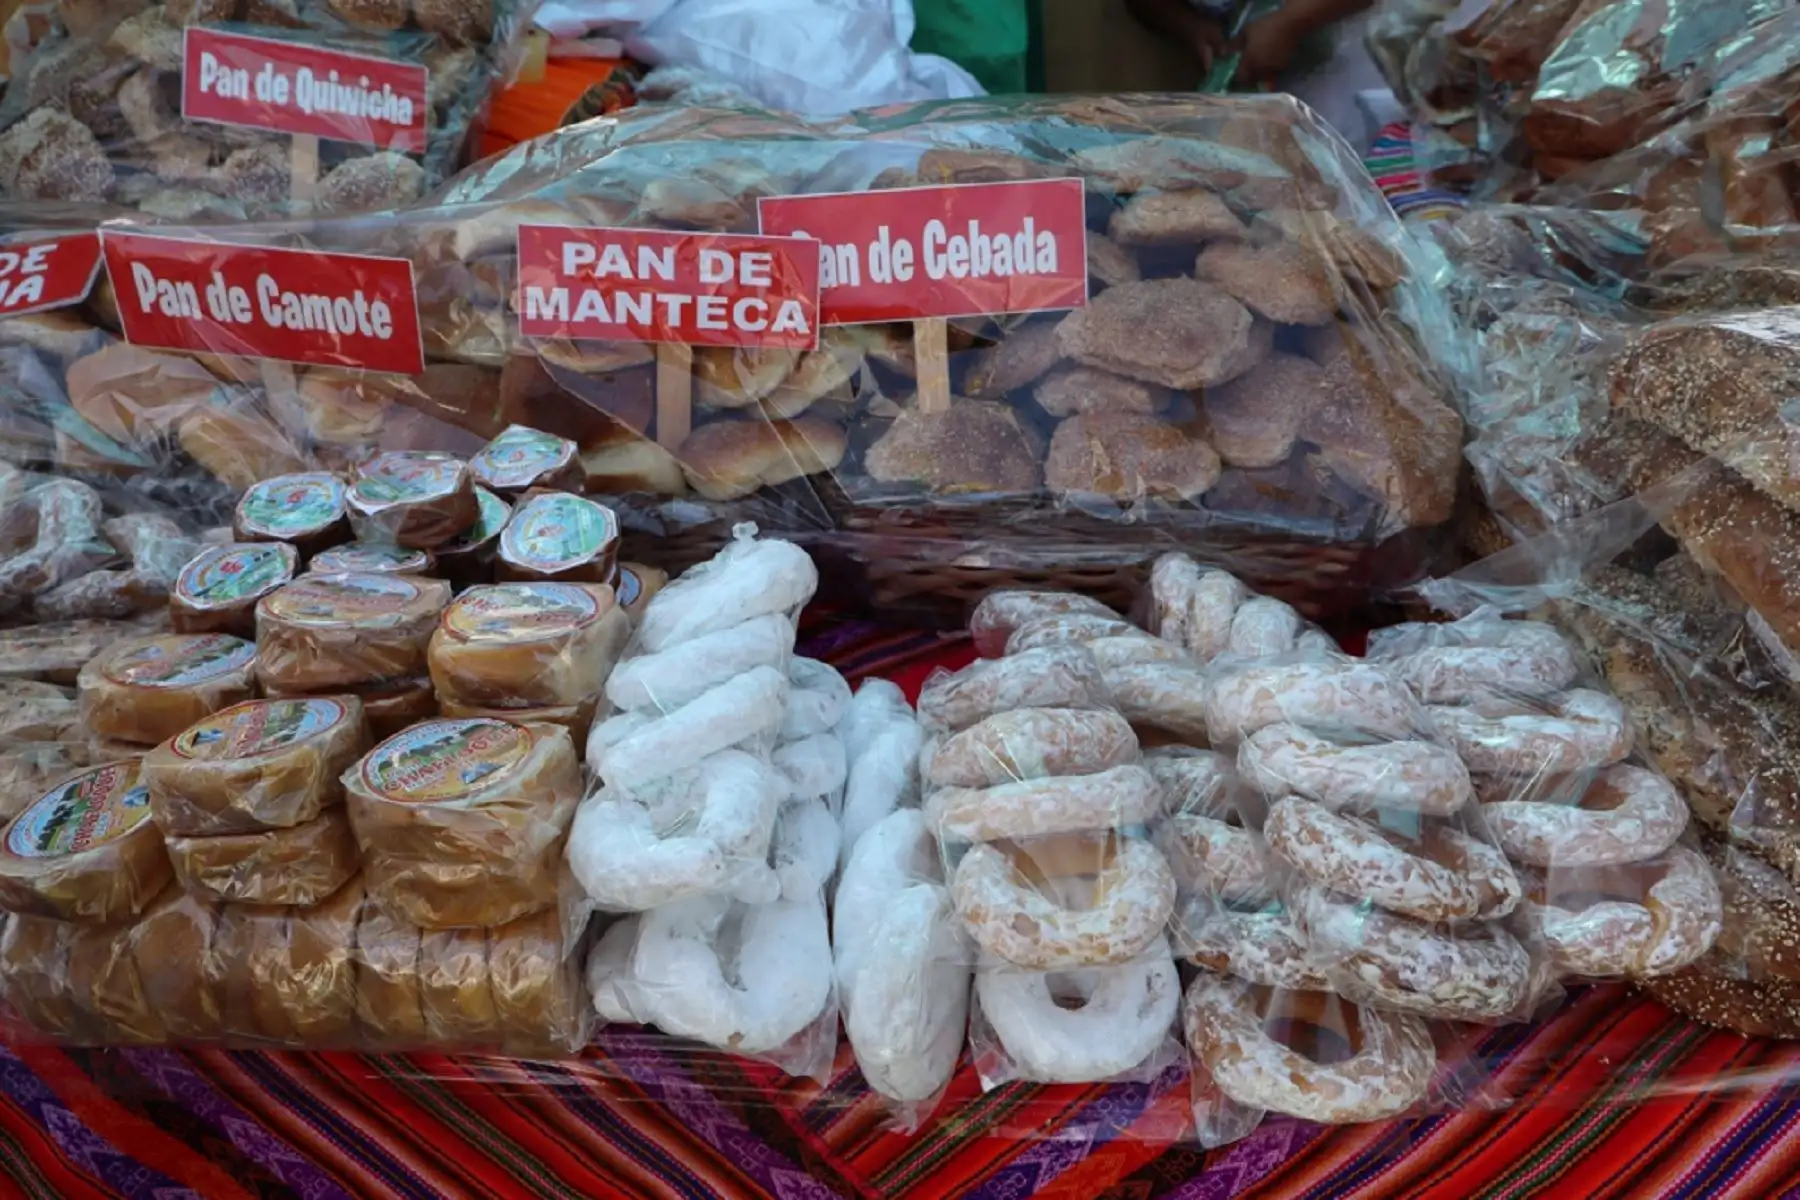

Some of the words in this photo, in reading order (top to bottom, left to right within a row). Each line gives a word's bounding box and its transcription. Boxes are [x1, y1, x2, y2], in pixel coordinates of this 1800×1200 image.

[200, 53, 251, 99] Pan
[255, 64, 289, 104] de
[295, 66, 413, 125] Quiwicha
[563, 243, 675, 281] PAN
[700, 250, 773, 287] DE
[792, 230, 860, 288] an
[868, 227, 913, 283] de
[923, 217, 1057, 279] Cebada
[131, 261, 202, 321] Pan
[207, 272, 253, 324] de
[259, 277, 393, 339] Camote
[526, 287, 811, 333] MANTECA
